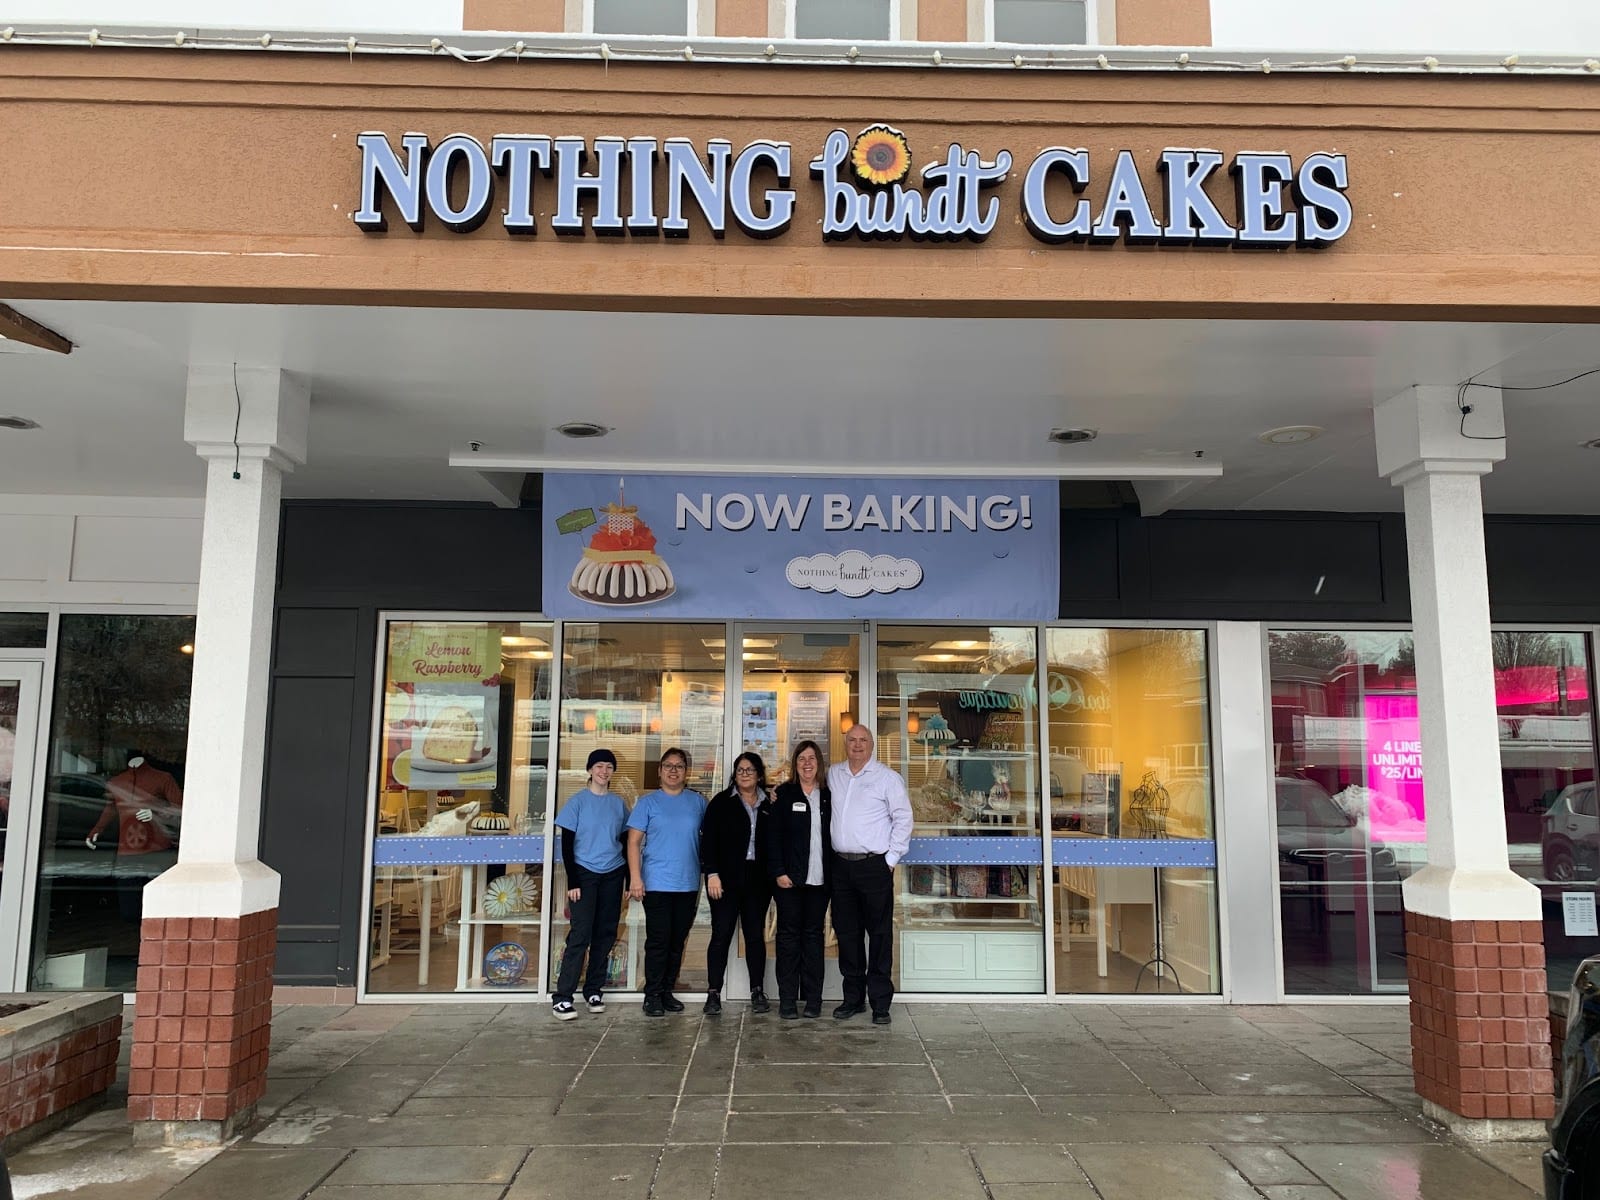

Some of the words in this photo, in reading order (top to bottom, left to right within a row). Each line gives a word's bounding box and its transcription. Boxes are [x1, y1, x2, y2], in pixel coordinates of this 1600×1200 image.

[354, 132, 796, 236] NOTHING
[810, 128, 1013, 238] bundt
[1022, 148, 1355, 243] CAKES
[676, 493, 811, 531] NOW
[823, 494, 1033, 531] BAKING!
[798, 568, 838, 577] NOTHING
[840, 562, 873, 580] bundt
[425, 641, 472, 659] Lemon
[412, 659, 483, 679] Raspberry
[1383, 741, 1392, 752] 4
[1394, 741, 1422, 753] LINE
